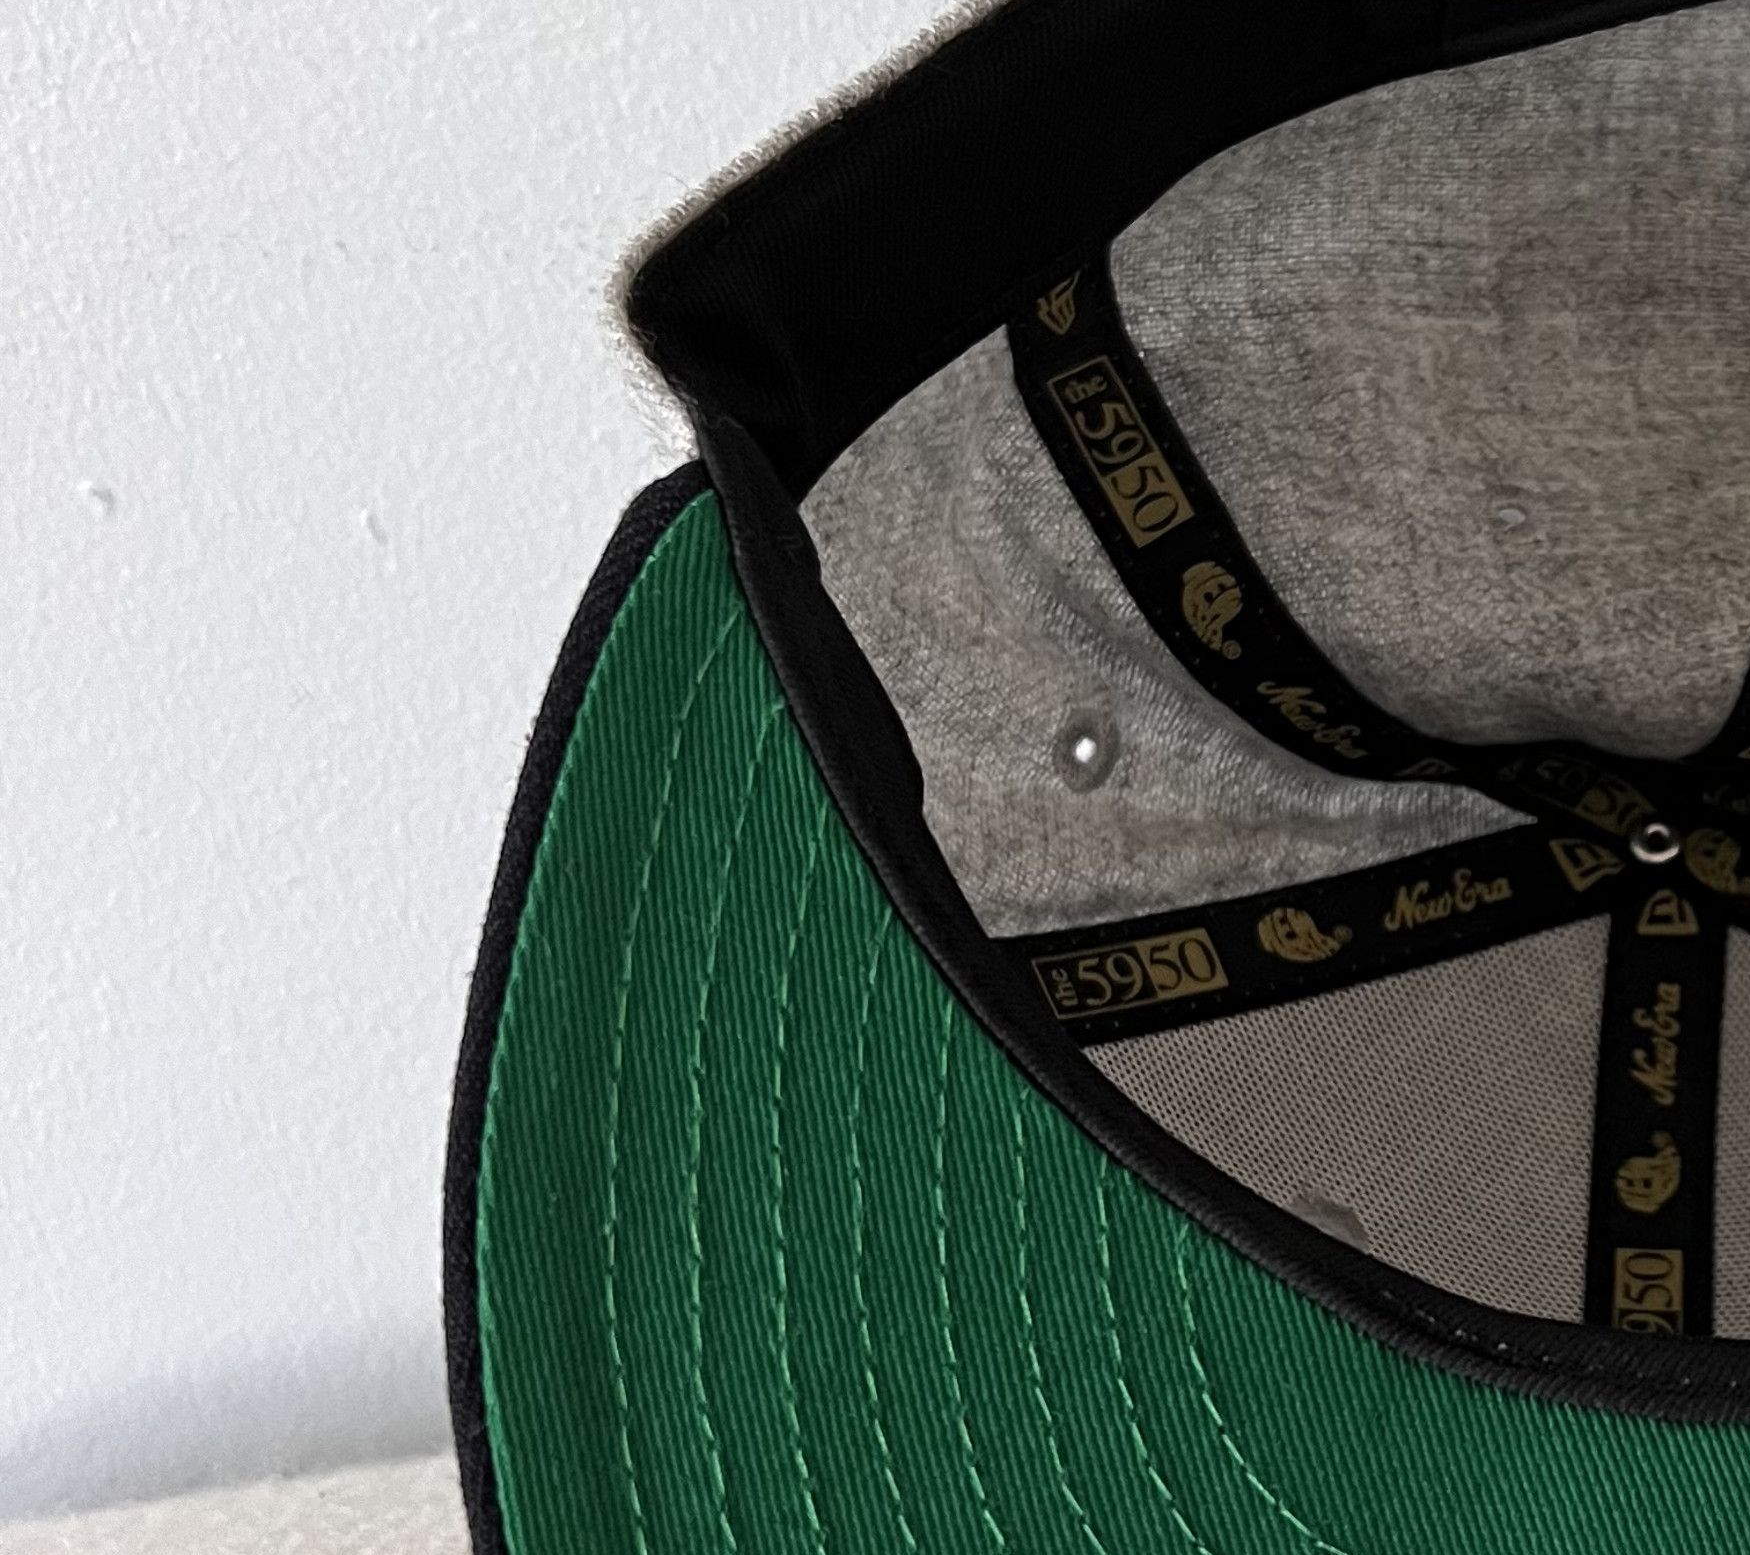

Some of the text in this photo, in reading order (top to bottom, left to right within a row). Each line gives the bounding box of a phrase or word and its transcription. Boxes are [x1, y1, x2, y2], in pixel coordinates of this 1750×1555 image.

[1074, 401, 1180, 534] 5950
[1077, 937, 1217, 1006] 5950
[1620, 1251, 1676, 1335] 950
